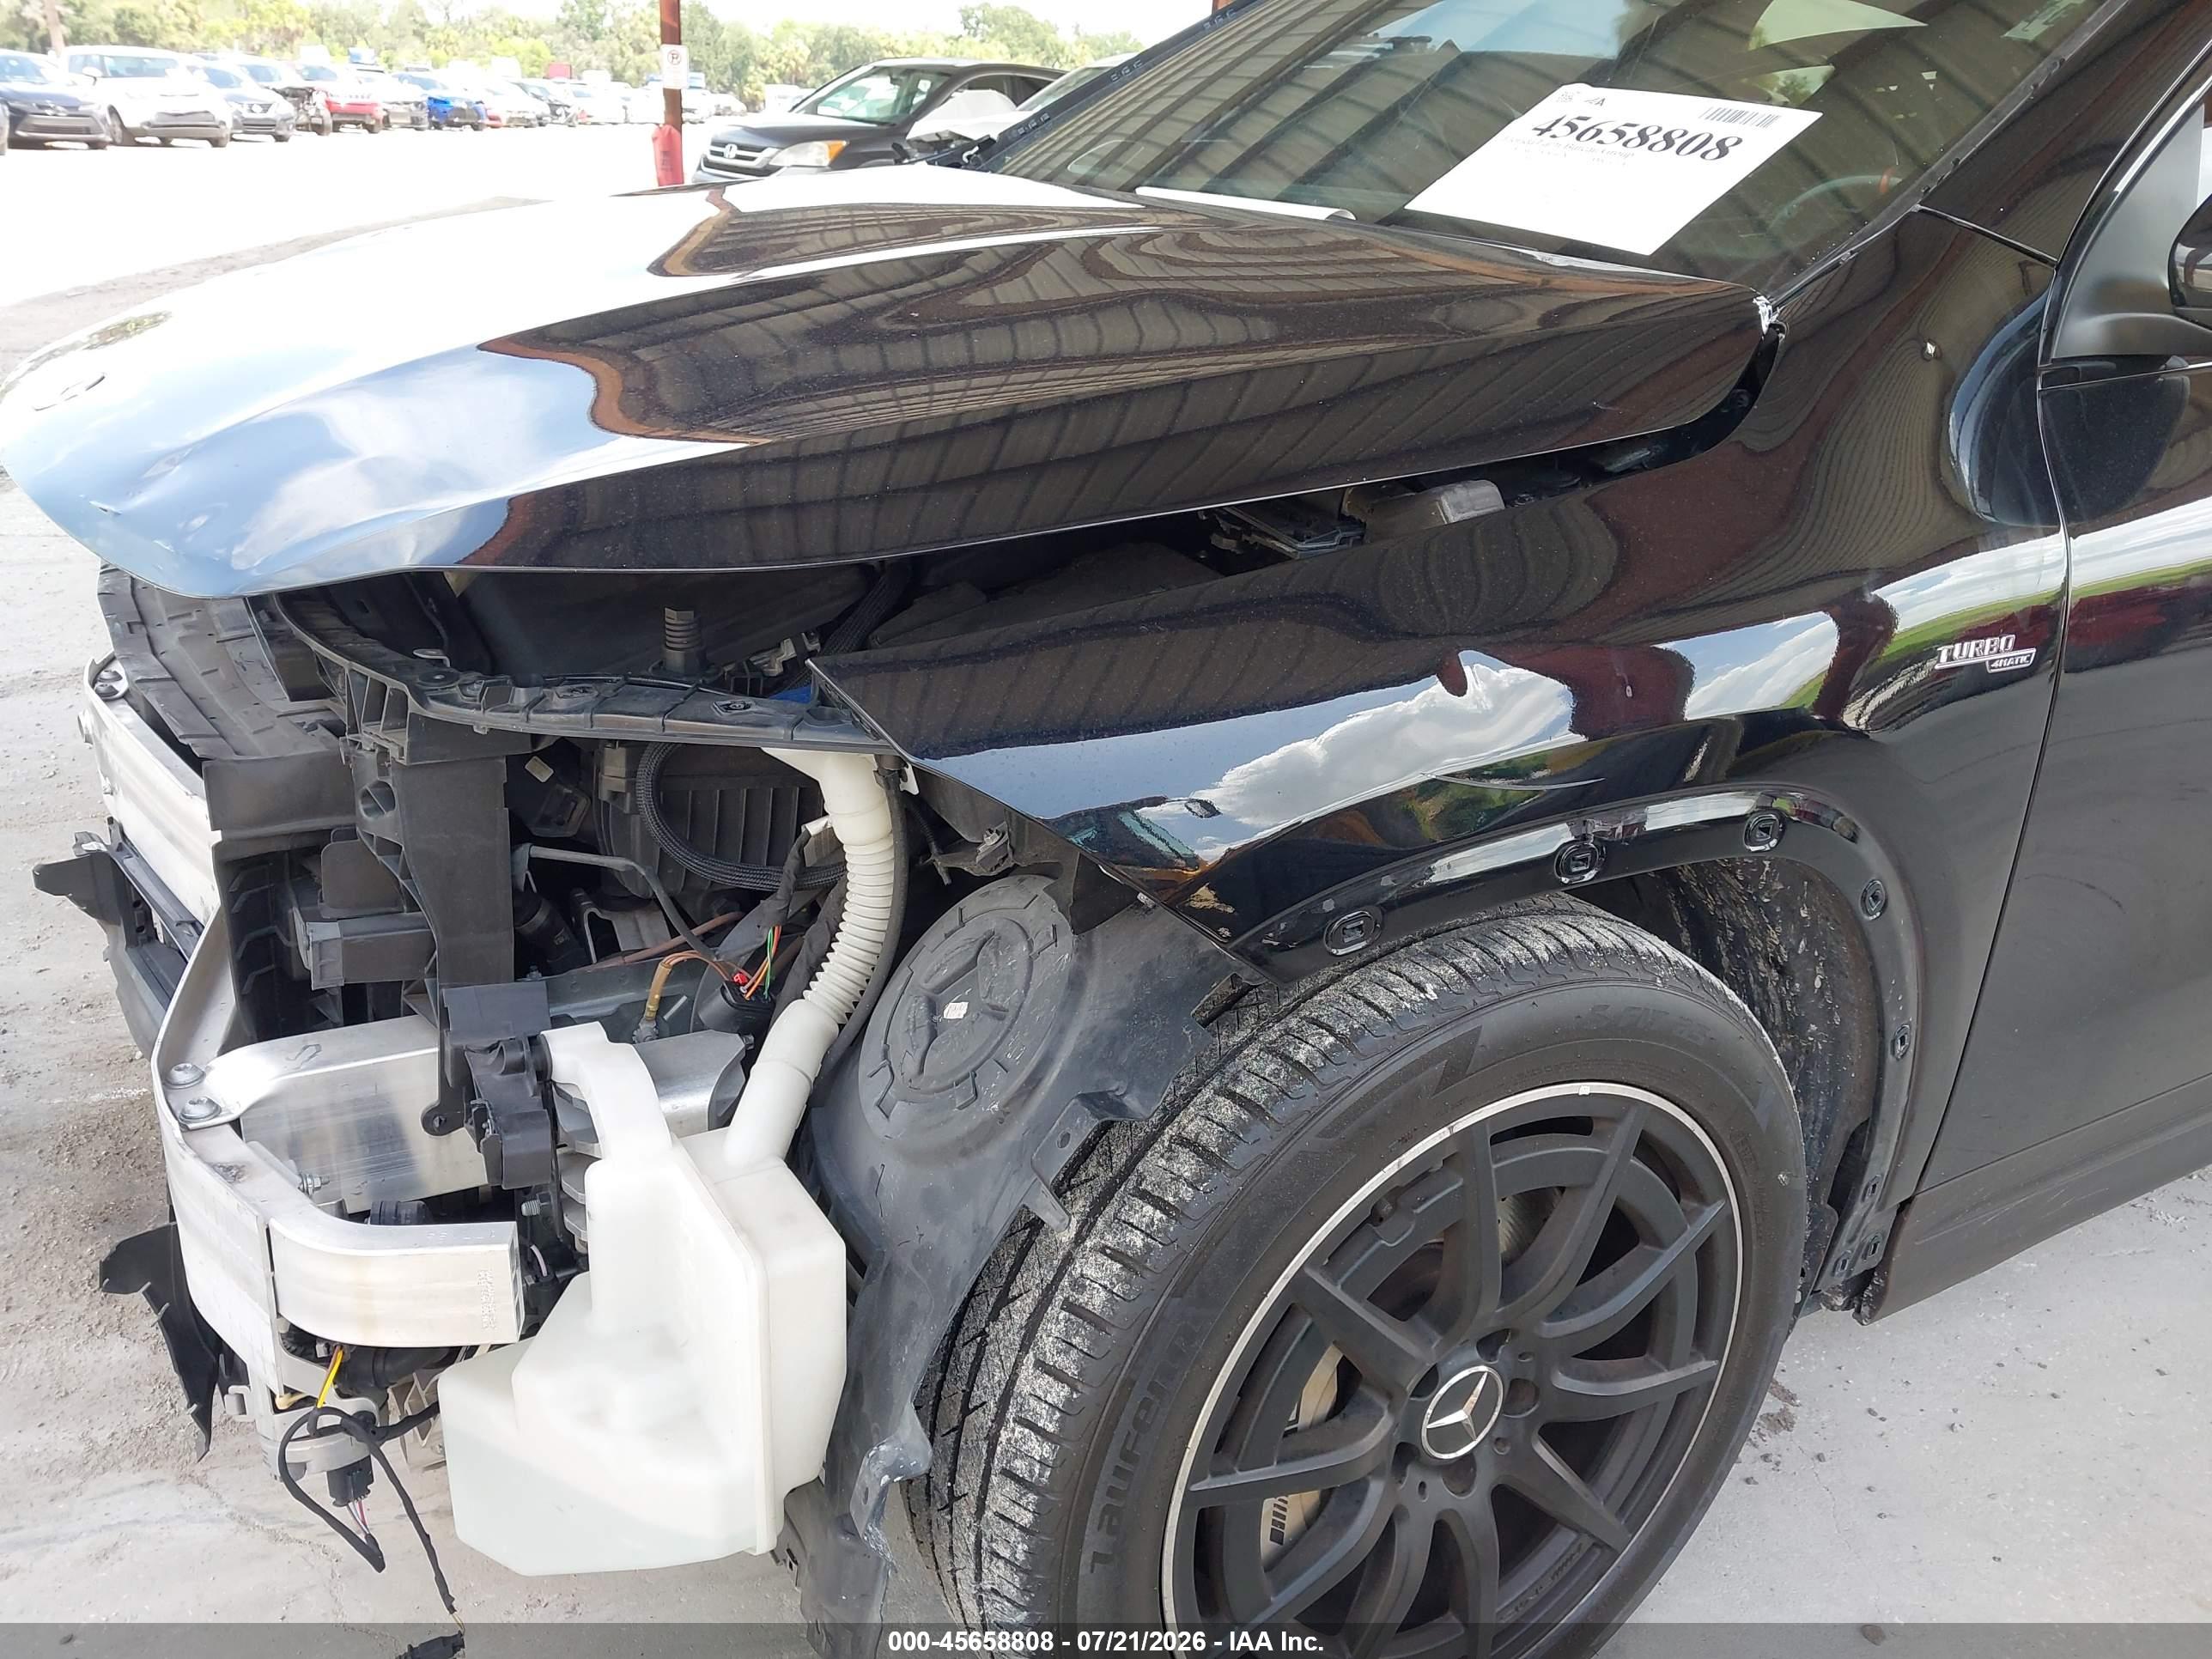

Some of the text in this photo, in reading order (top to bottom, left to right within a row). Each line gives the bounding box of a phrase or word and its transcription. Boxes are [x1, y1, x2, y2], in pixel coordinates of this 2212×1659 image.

[1532, 114, 1742, 161] 45658808
[1936, 635, 2015, 663] TURBO
[1990, 653, 2031, 668] 4MATIC
